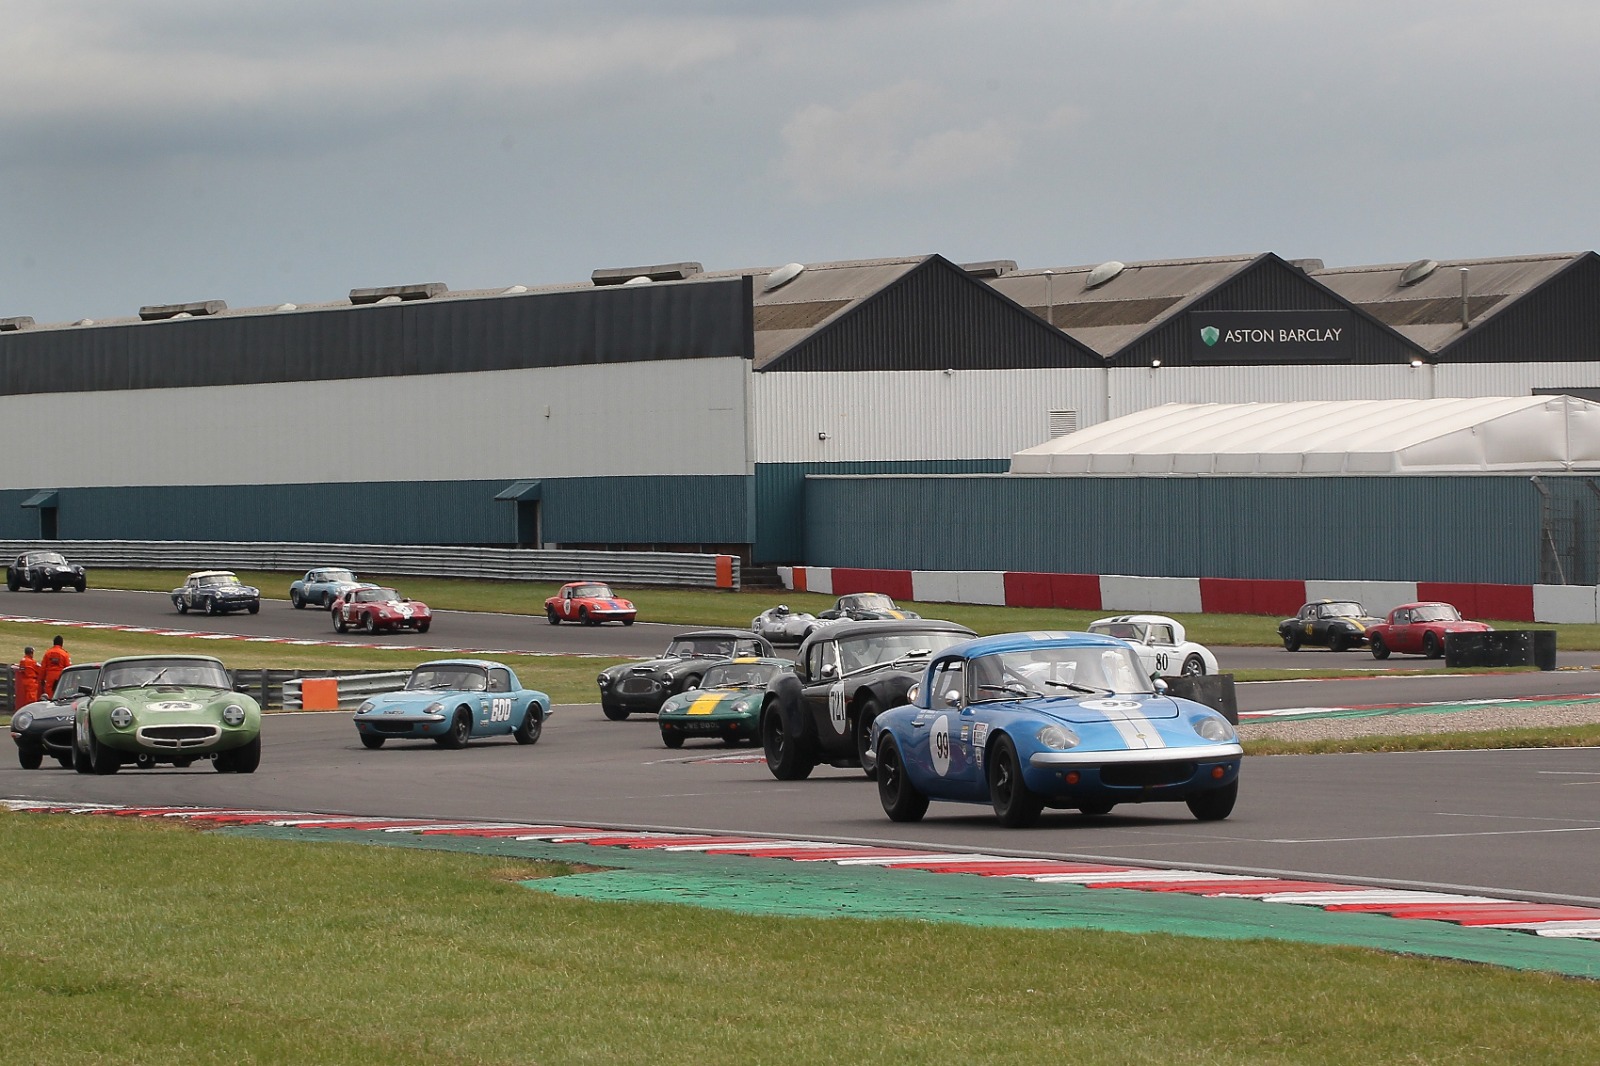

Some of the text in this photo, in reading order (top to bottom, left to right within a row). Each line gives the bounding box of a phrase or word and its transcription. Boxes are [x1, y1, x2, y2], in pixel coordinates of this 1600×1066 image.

[1224, 328, 1342, 343] ASTON BARCLAY
[1155, 652, 1169, 671] 80
[490, 698, 512, 722] 600
[831, 690, 845, 720] 721
[936, 731, 949, 759] 99
